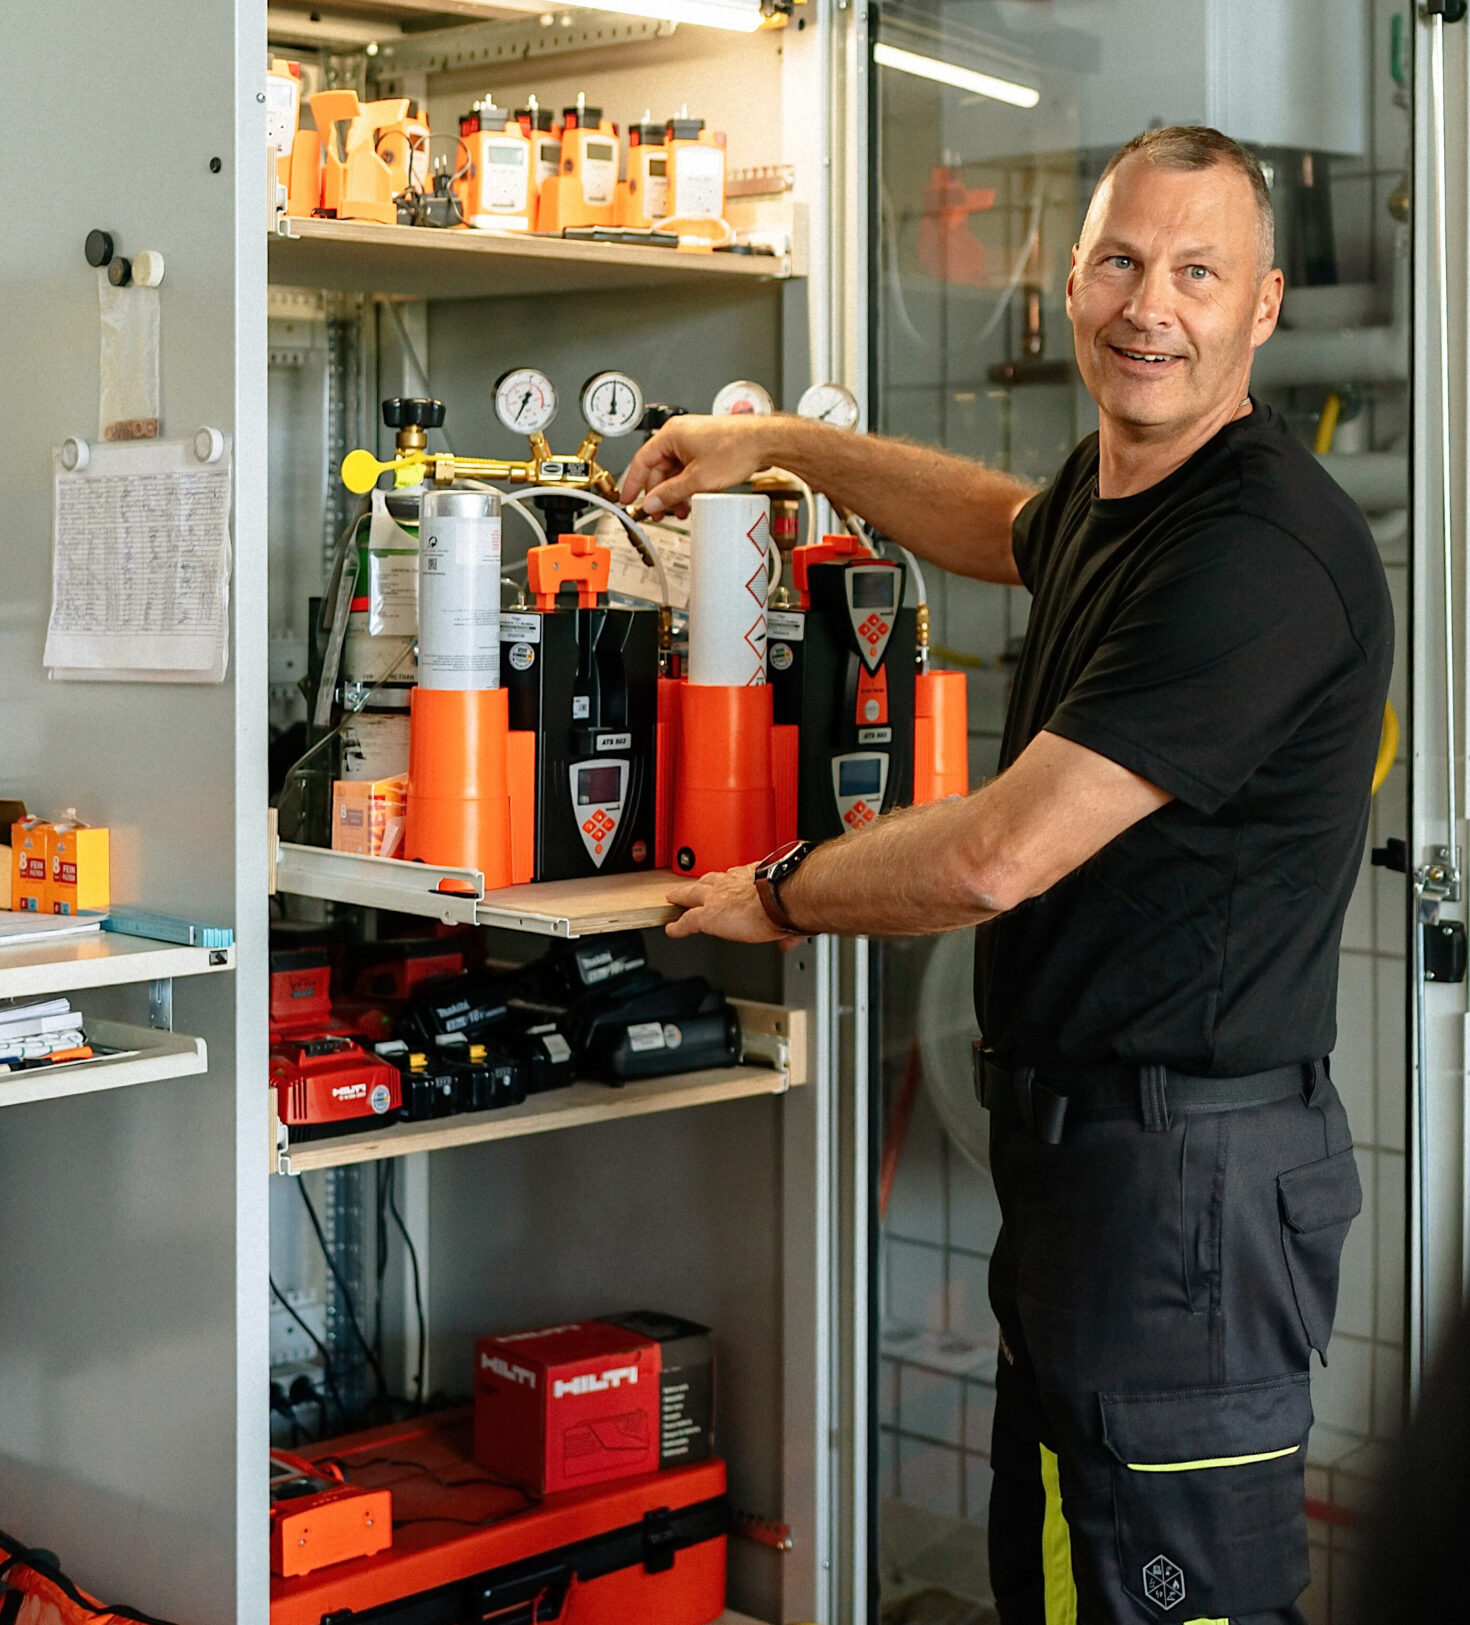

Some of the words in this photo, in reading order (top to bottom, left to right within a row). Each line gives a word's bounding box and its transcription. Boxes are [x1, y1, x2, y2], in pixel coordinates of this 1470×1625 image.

[19, 852, 27, 870] 8
[29, 860, 43, 870] FEIN
[52, 855, 60, 874] 8
[62, 864, 75, 874] FEIN
[332, 1083, 366, 1097] HILTI
[481, 1351, 536, 1390] HILTI
[553, 1365, 638, 1399] HILTI
